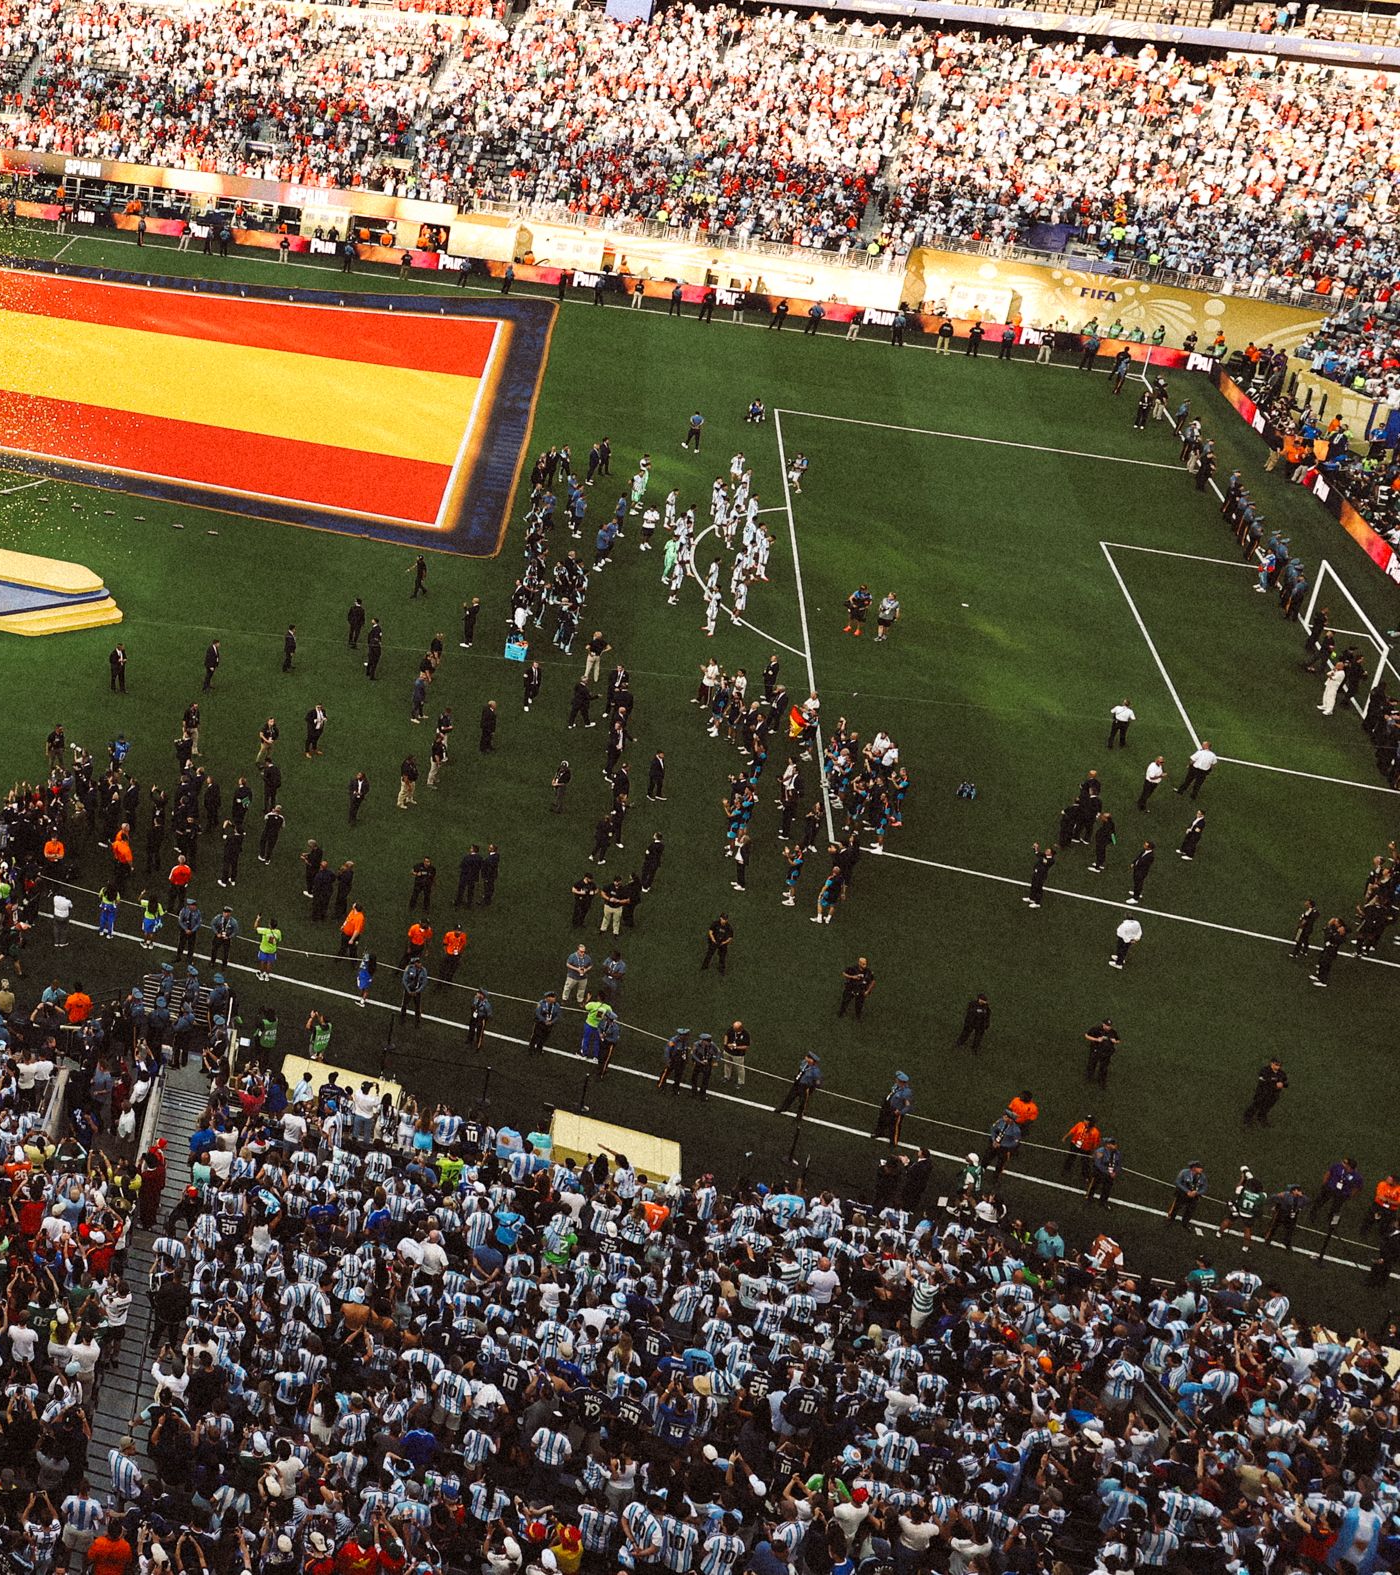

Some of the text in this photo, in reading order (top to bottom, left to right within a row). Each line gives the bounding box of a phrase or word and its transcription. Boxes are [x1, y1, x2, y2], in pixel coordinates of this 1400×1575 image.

[65, 159, 102, 177] SPAIN
[311, 238, 336, 255] PAIN
[1080, 287, 1117, 303] FIFA
[466, 1130, 477, 1142] 10
[222, 1224, 236, 1234] 20
[745, 1287, 757, 1298] 19
[646, 1342, 659, 1355] 10
[503, 1375, 518, 1390] 10
[750, 1382, 769, 1396] 26
[584, 1402, 600, 1416] 19
[799, 1400, 815, 1413] 10
[892, 1445, 908, 1460] 10
[780, 1463, 791, 1475] 10
[1174, 1505, 1192, 1521] 10
[669, 1532, 686, 1551] 10
[718, 1546, 737, 1564] 10
